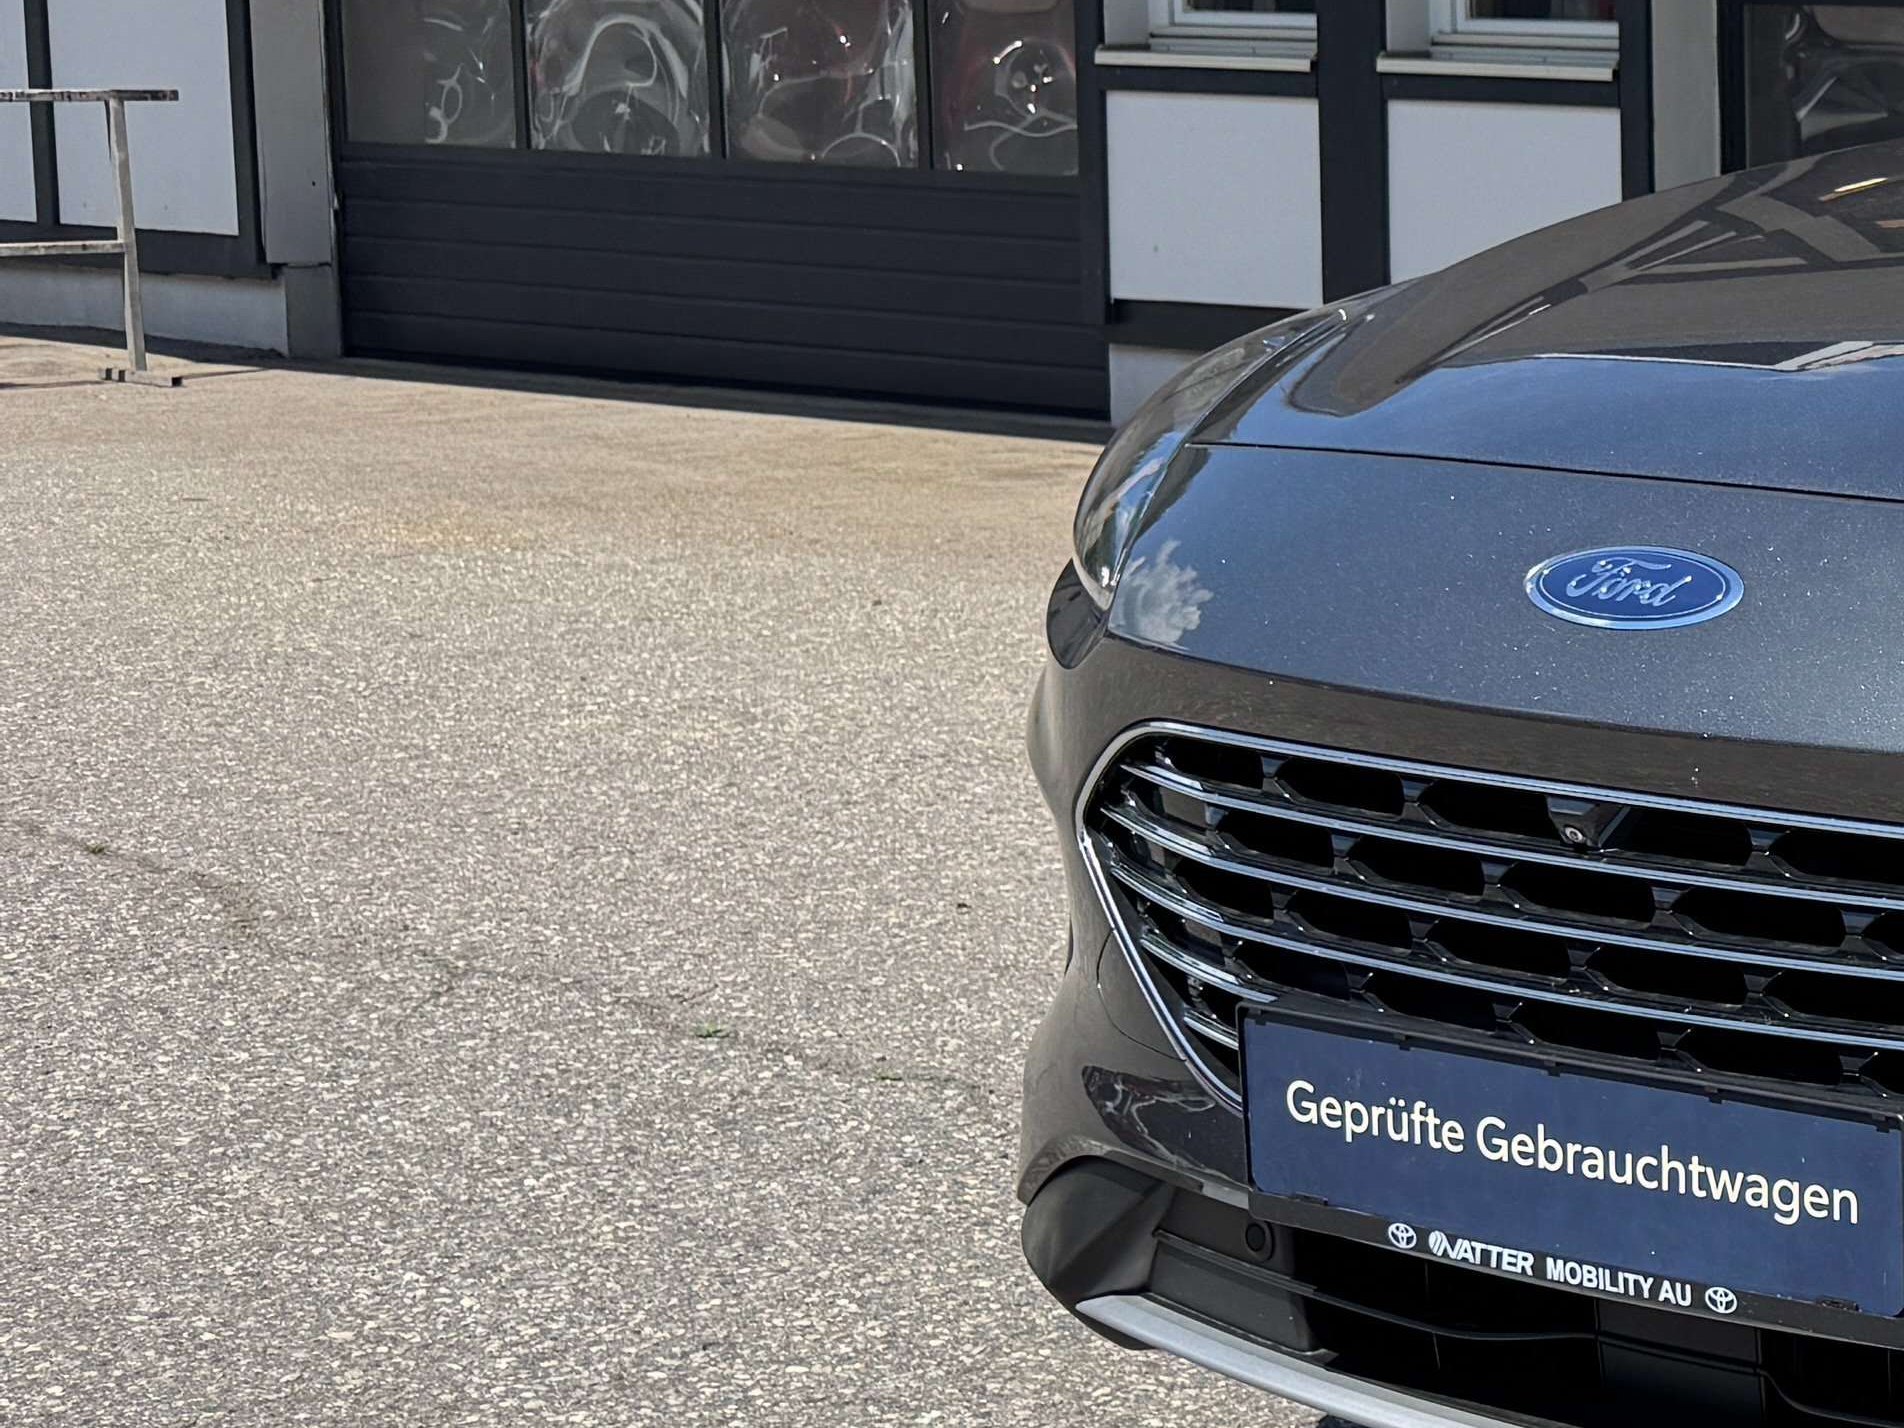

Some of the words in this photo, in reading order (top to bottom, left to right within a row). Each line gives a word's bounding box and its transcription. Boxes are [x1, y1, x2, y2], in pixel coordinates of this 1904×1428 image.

[1566, 556, 1692, 607] Ford
[1286, 1079, 1465, 1154] Geprüfte
[1476, 1115, 1859, 1226] Gebrauchtwagen
[1546, 1256, 1654, 1299] MOBILITY
[1658, 1280, 1692, 1307] AU
